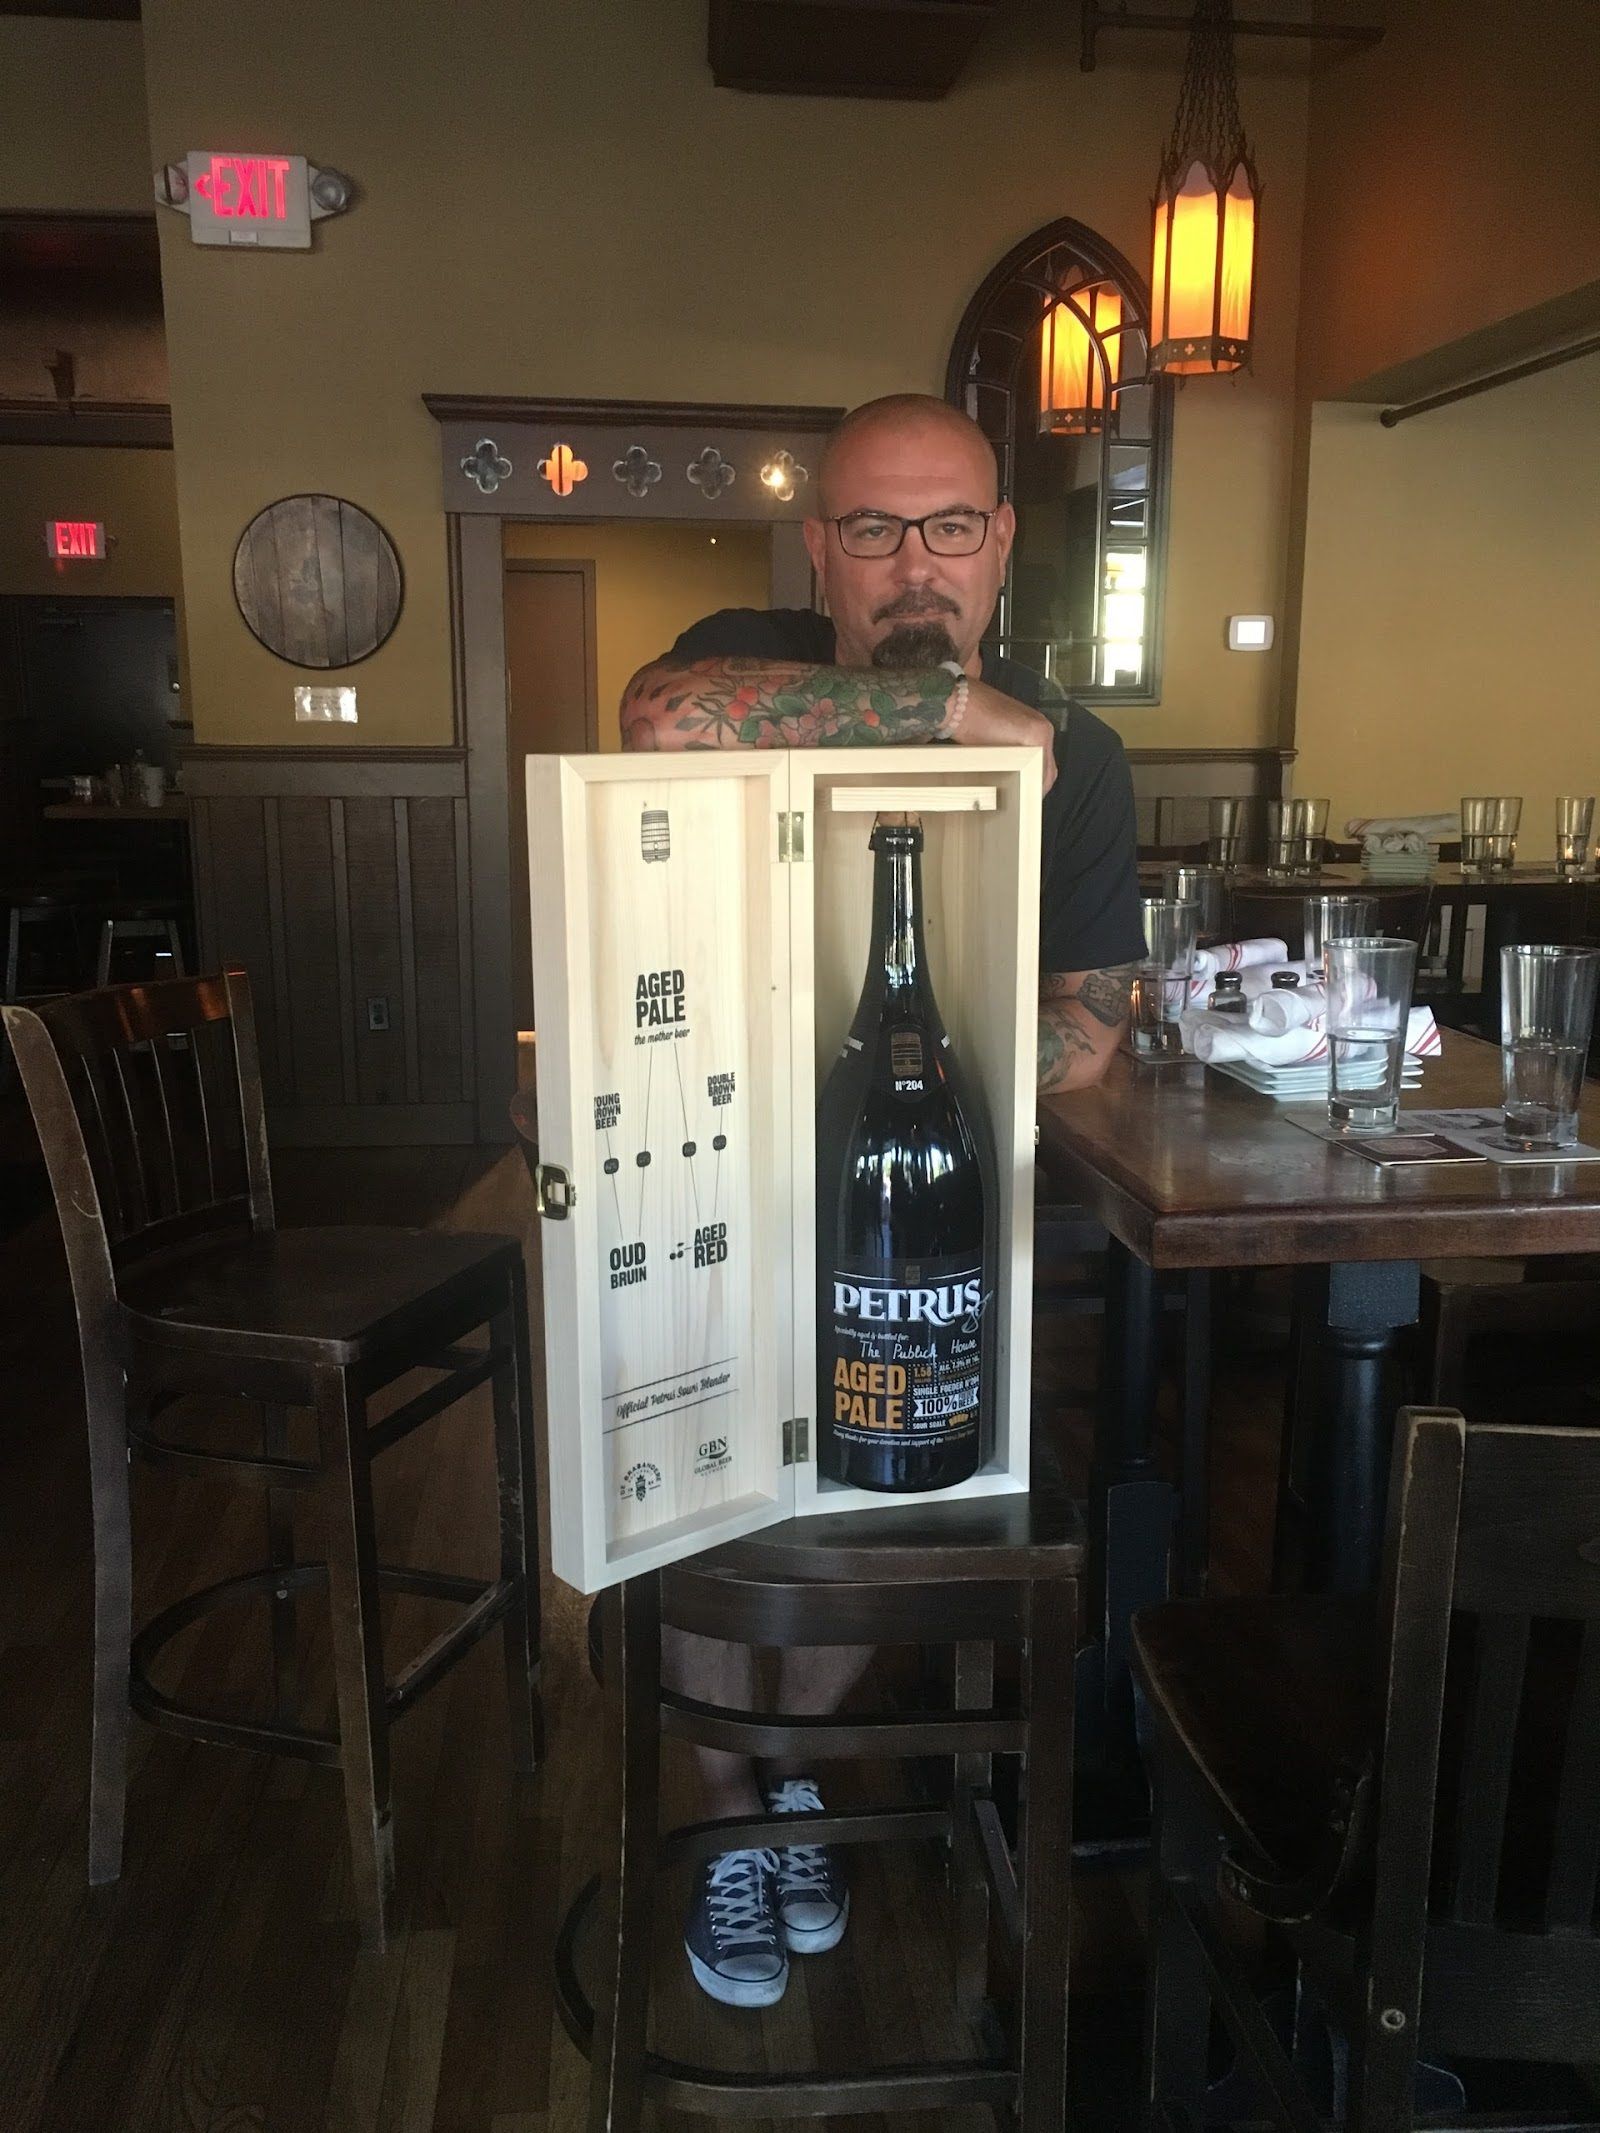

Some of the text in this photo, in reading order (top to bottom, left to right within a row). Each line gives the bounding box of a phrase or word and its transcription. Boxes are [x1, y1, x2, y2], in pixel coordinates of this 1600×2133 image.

[211, 157, 290, 218] EXIT
[55, 522, 96, 556] EXIT
[636, 969, 685, 1000] AGED
[636, 995, 686, 1028] PALE
[634, 1028, 690, 1045] the mother beer
[707, 1072, 735, 1086] DOUBLE
[708, 1083, 735, 1097] BROWN
[712, 1094, 732, 1107] BEER
[595, 1116, 617, 1130] BEER
[694, 1222, 727, 1246] AGED
[609, 1241, 646, 1271] OUD
[694, 1240, 728, 1269] RED
[610, 1266, 647, 1290] BRUIN
[833, 1278, 982, 1327] PETRUS
[860, 1340, 881, 1358] The
[950, 1339, 977, 1354] House
[834, 1357, 906, 1396] AGED
[913, 1386, 939, 1397] SINGLE
[939, 1380, 964, 1395] FOEDER
[616, 1396, 650, 1420] Official
[651, 1390, 676, 1406] Petrus
[700, 1373, 731, 1392] Blender
[920, 1393, 957, 1415] 100%
[834, 1390, 904, 1430] PALE
[912, 1422, 928, 1430] SOUR
[699, 1436, 727, 1456] GBN
